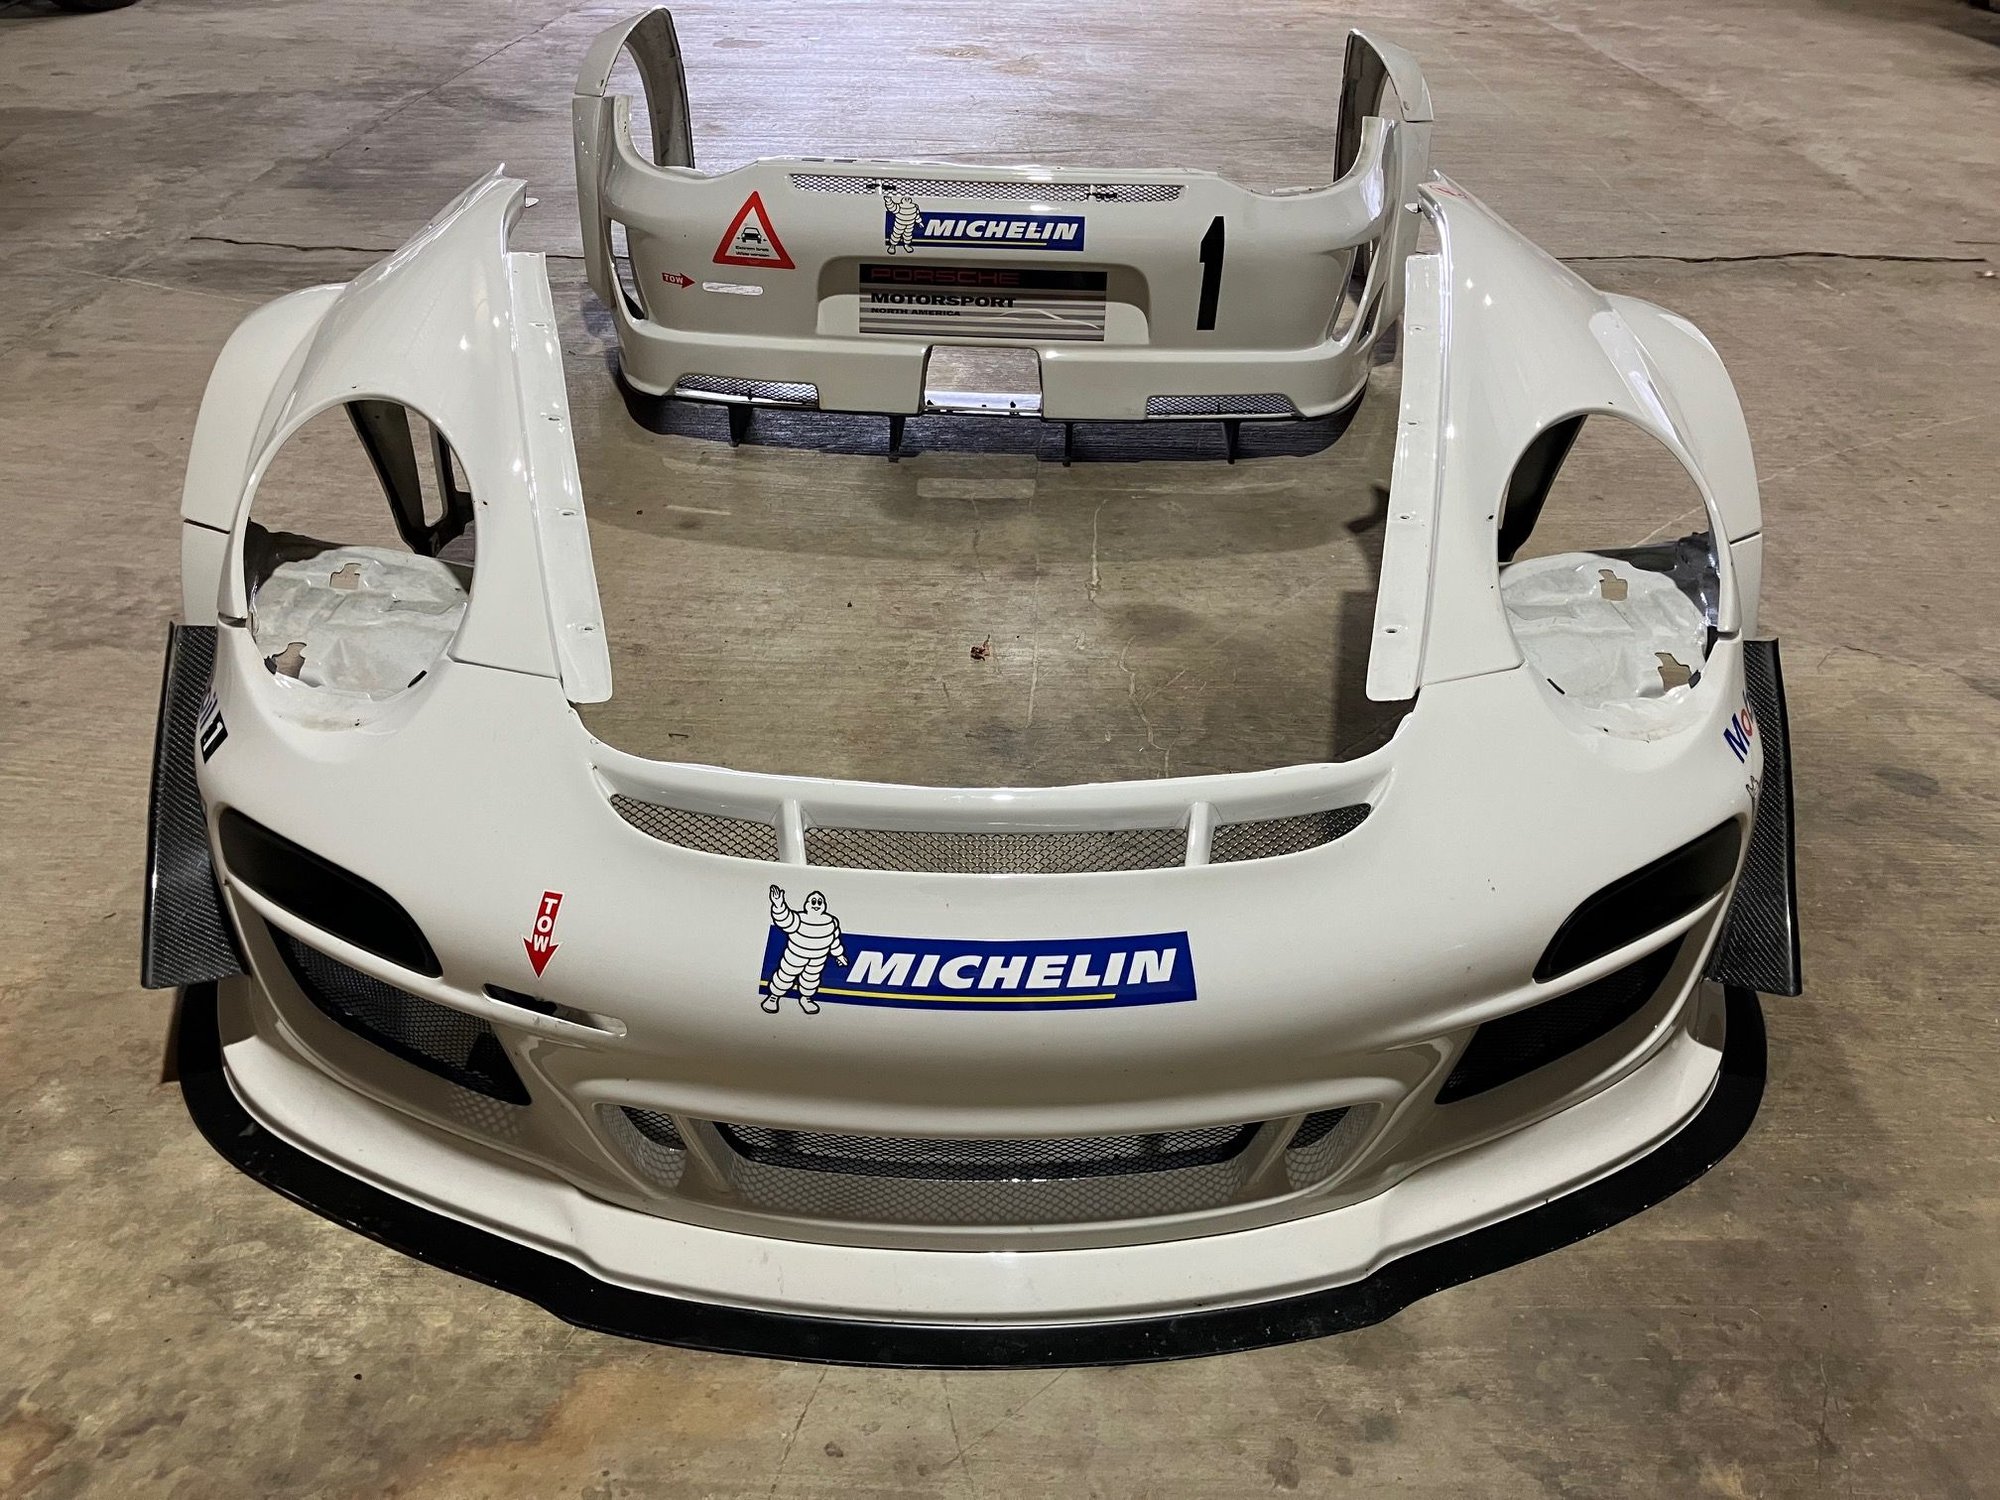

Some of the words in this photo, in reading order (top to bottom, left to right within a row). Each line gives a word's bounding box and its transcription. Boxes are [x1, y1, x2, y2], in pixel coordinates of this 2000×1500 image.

[924, 219, 1079, 241] MICHELIN
[663, 273, 684, 284] TOW
[871, 268, 1020, 285] PORSCHE
[1196, 215, 1225, 331] 1
[871, 292, 1017, 308] MOTORSPORT
[871, 307, 909, 315] NORTH
[910, 308, 961, 317] AMERICA
[533, 897, 559, 952] TOW
[846, 948, 1178, 990] MICHELIN
